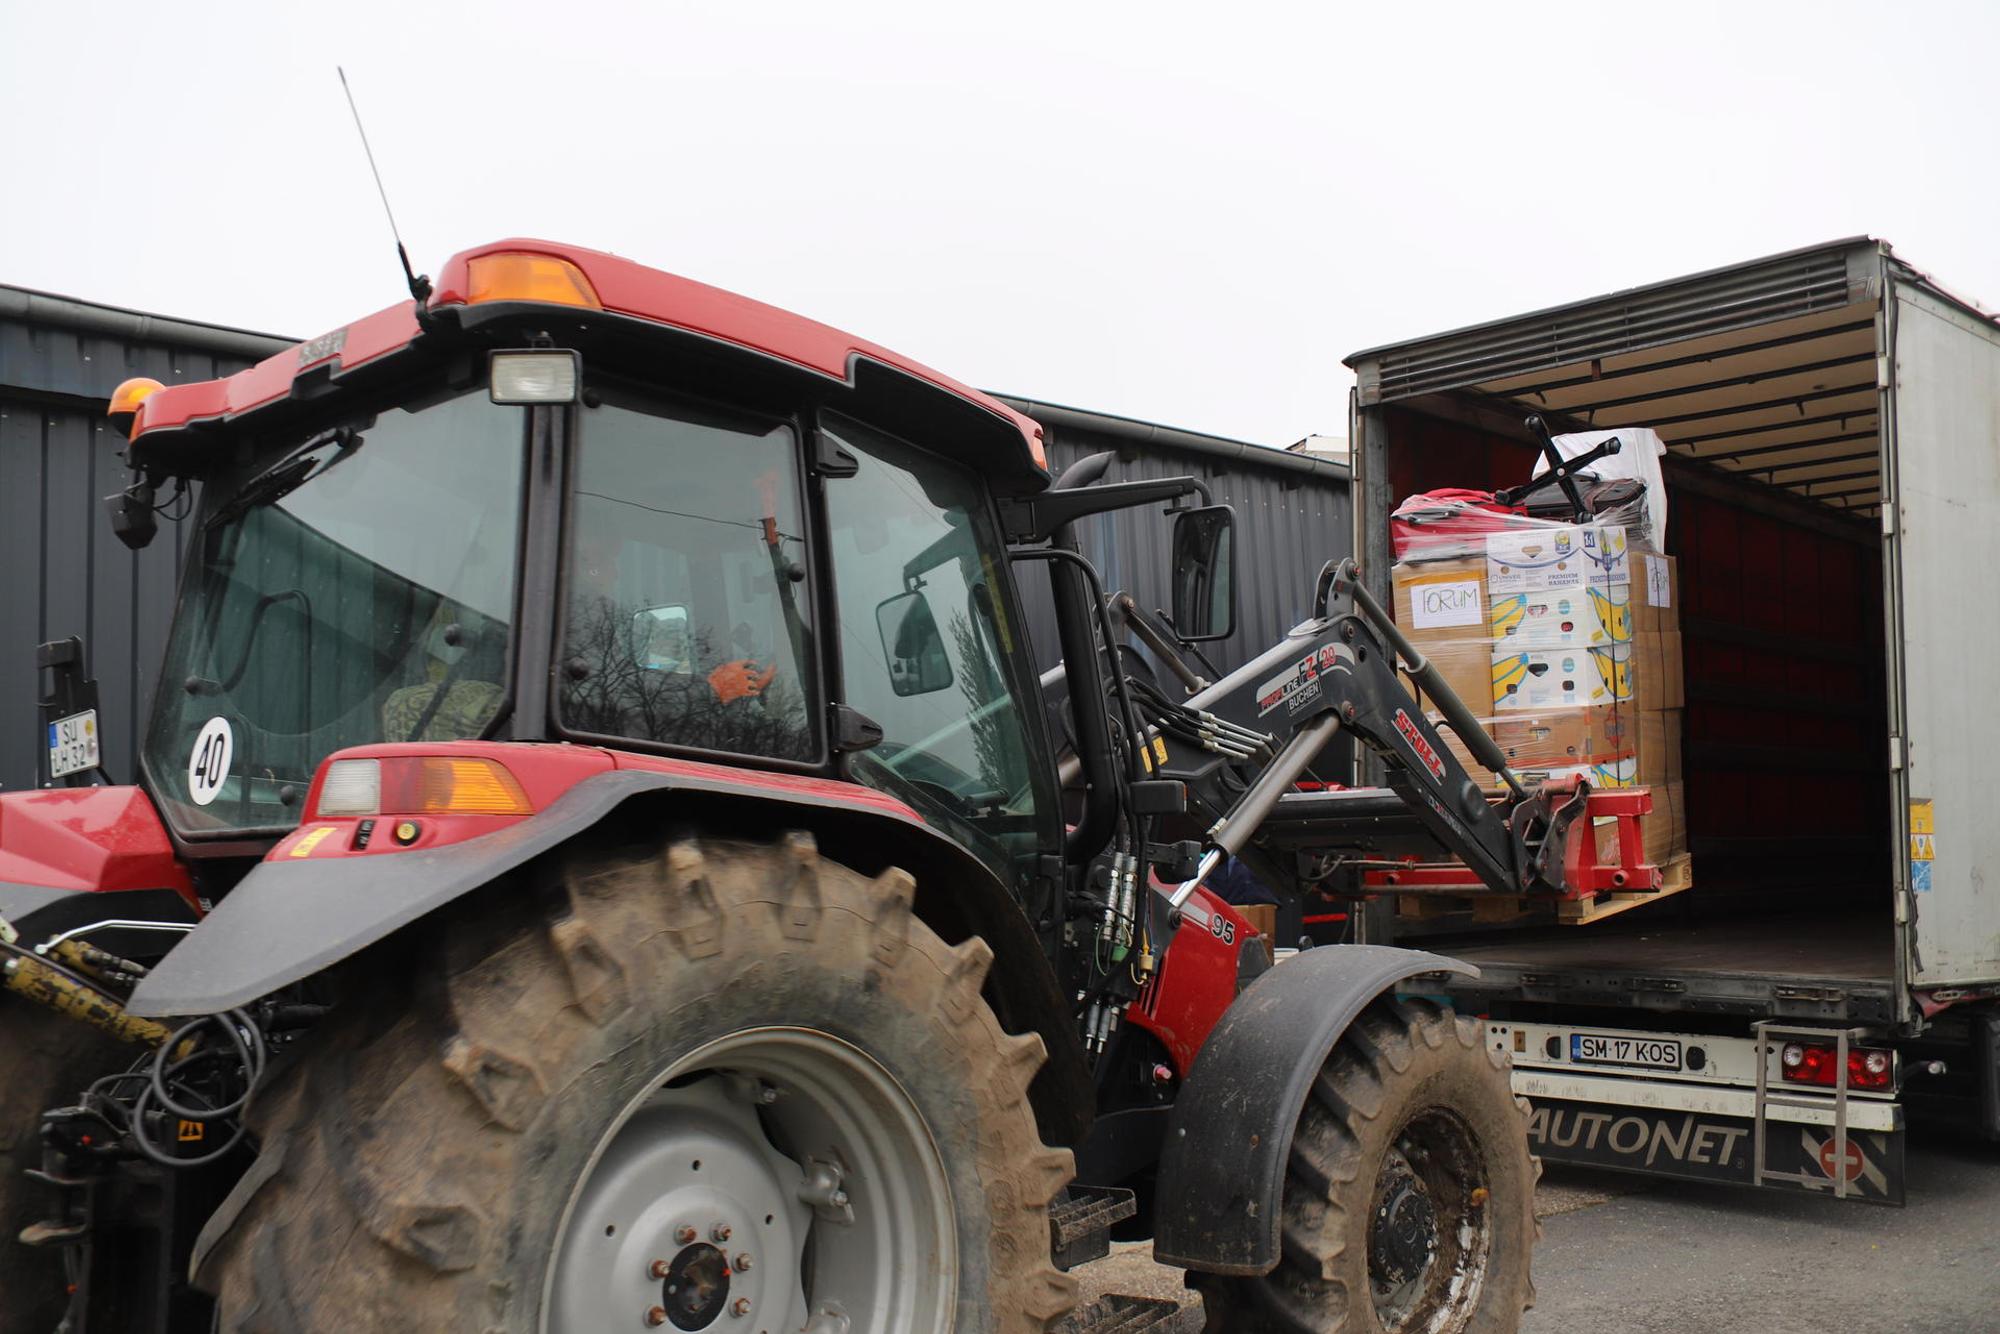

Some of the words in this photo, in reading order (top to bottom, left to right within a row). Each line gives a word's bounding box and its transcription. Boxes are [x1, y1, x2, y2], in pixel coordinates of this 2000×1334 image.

[1288, 682, 1319, 711] BUCHEN
[63, 720, 78, 744] SU
[1395, 710, 1441, 777] STOLL
[72, 743, 86, 768] 32
[195, 733, 224, 788] 40
[1212, 913, 1235, 945] 95
[1582, 1038, 1607, 1058] SM
[1614, 1041, 1631, 1060] 17
[1636, 1042, 1676, 1064] KOS
[1526, 1107, 1749, 1167] AUTONET
